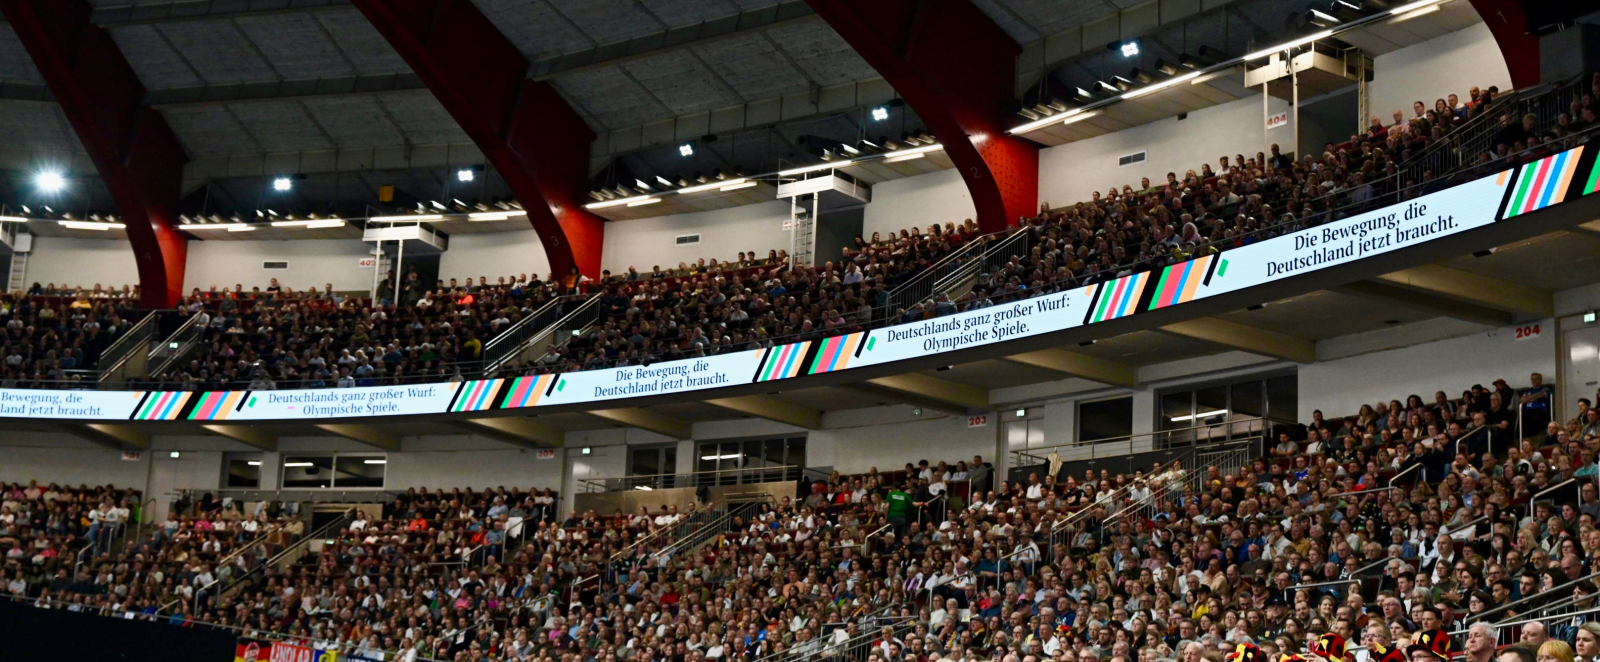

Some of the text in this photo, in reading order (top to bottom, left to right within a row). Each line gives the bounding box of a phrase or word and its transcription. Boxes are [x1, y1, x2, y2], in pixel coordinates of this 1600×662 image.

[1267, 113, 1286, 126] 404
[970, 166, 981, 179] 2
[1294, 202, 1427, 251] Die Bewegung, die
[550, 235, 560, 246] 3
[1266, 214, 1458, 277] Deutschland jetzt braucht.
[887, 294, 1070, 343] Deutschlands ganz großer Wurf:
[923, 320, 1030, 352] Olympische Spiele.
[1515, 324, 1541, 339] 204
[616, 360, 709, 382] Die Bewegung, die
[594, 372, 729, 397] Deutschland jetzt braucht.
[1, 392, 83, 405] Bewegung, die
[268, 386, 436, 404] Deutschlands ganz großer Wurf:
[28, 405, 54, 416] jetzt
[57, 405, 104, 416] braucht.
[303, 401, 400, 417] Olympische Spiele.
[968, 415, 987, 426] 203
